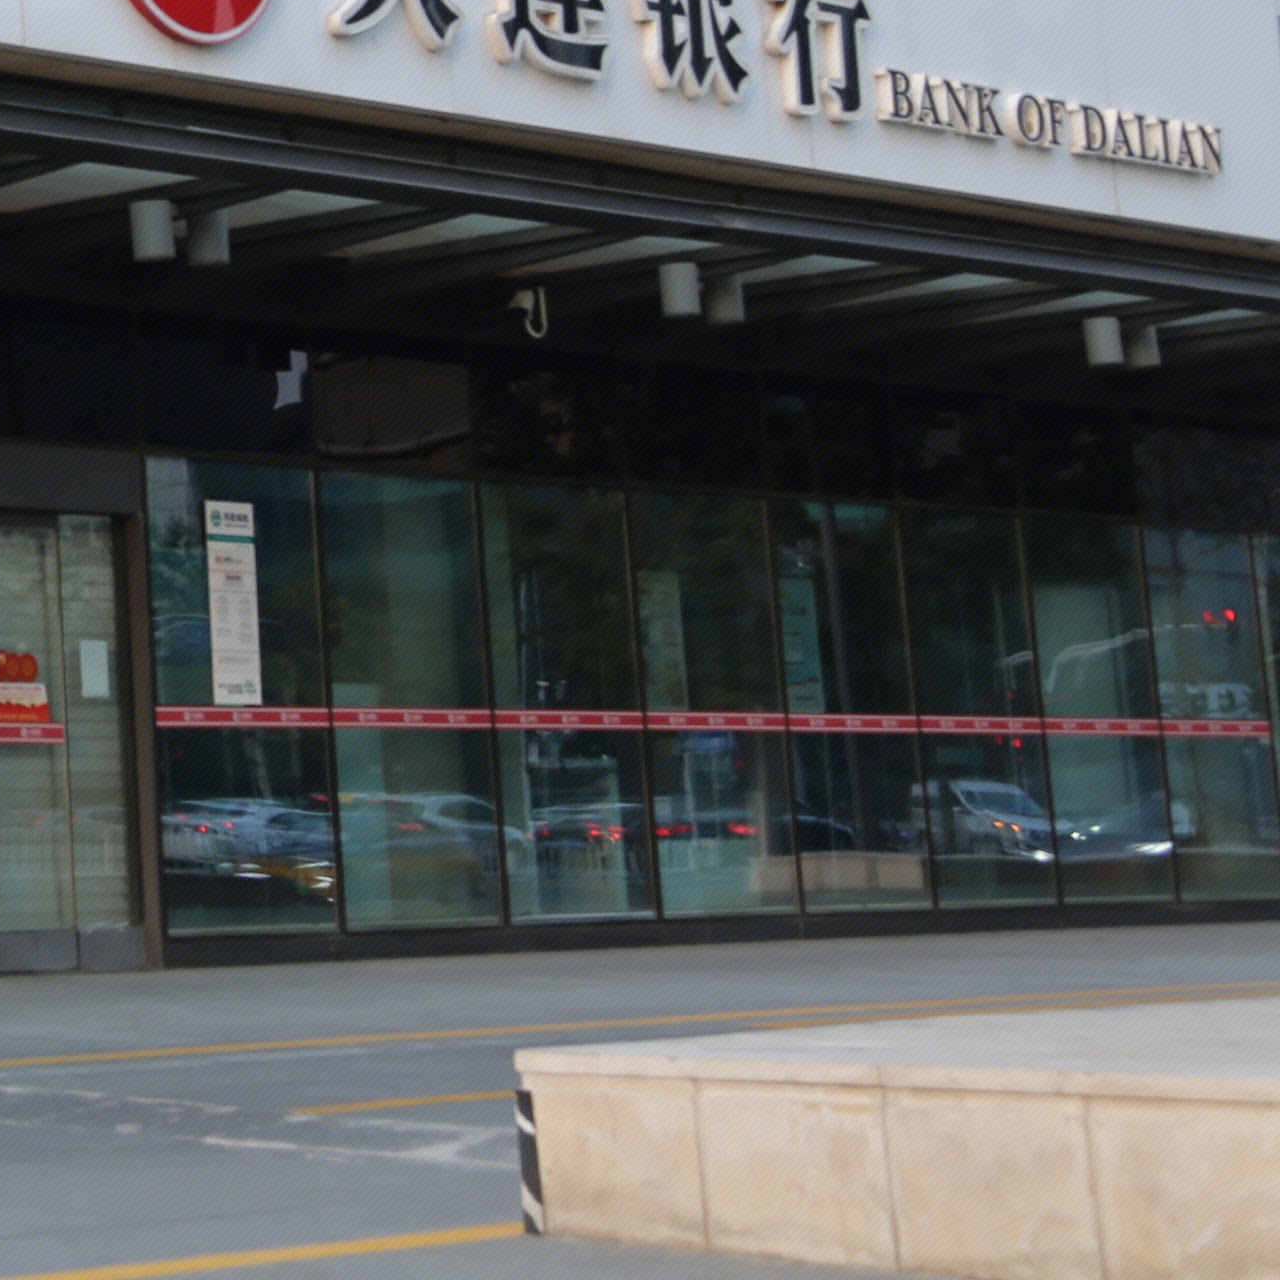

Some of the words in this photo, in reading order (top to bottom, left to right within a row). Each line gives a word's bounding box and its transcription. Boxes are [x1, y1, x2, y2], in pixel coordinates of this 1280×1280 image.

[887, 68, 1005, 137] BANK
[1016, 93, 1066, 146] OF
[1079, 104, 1223, 173] DALIAN
